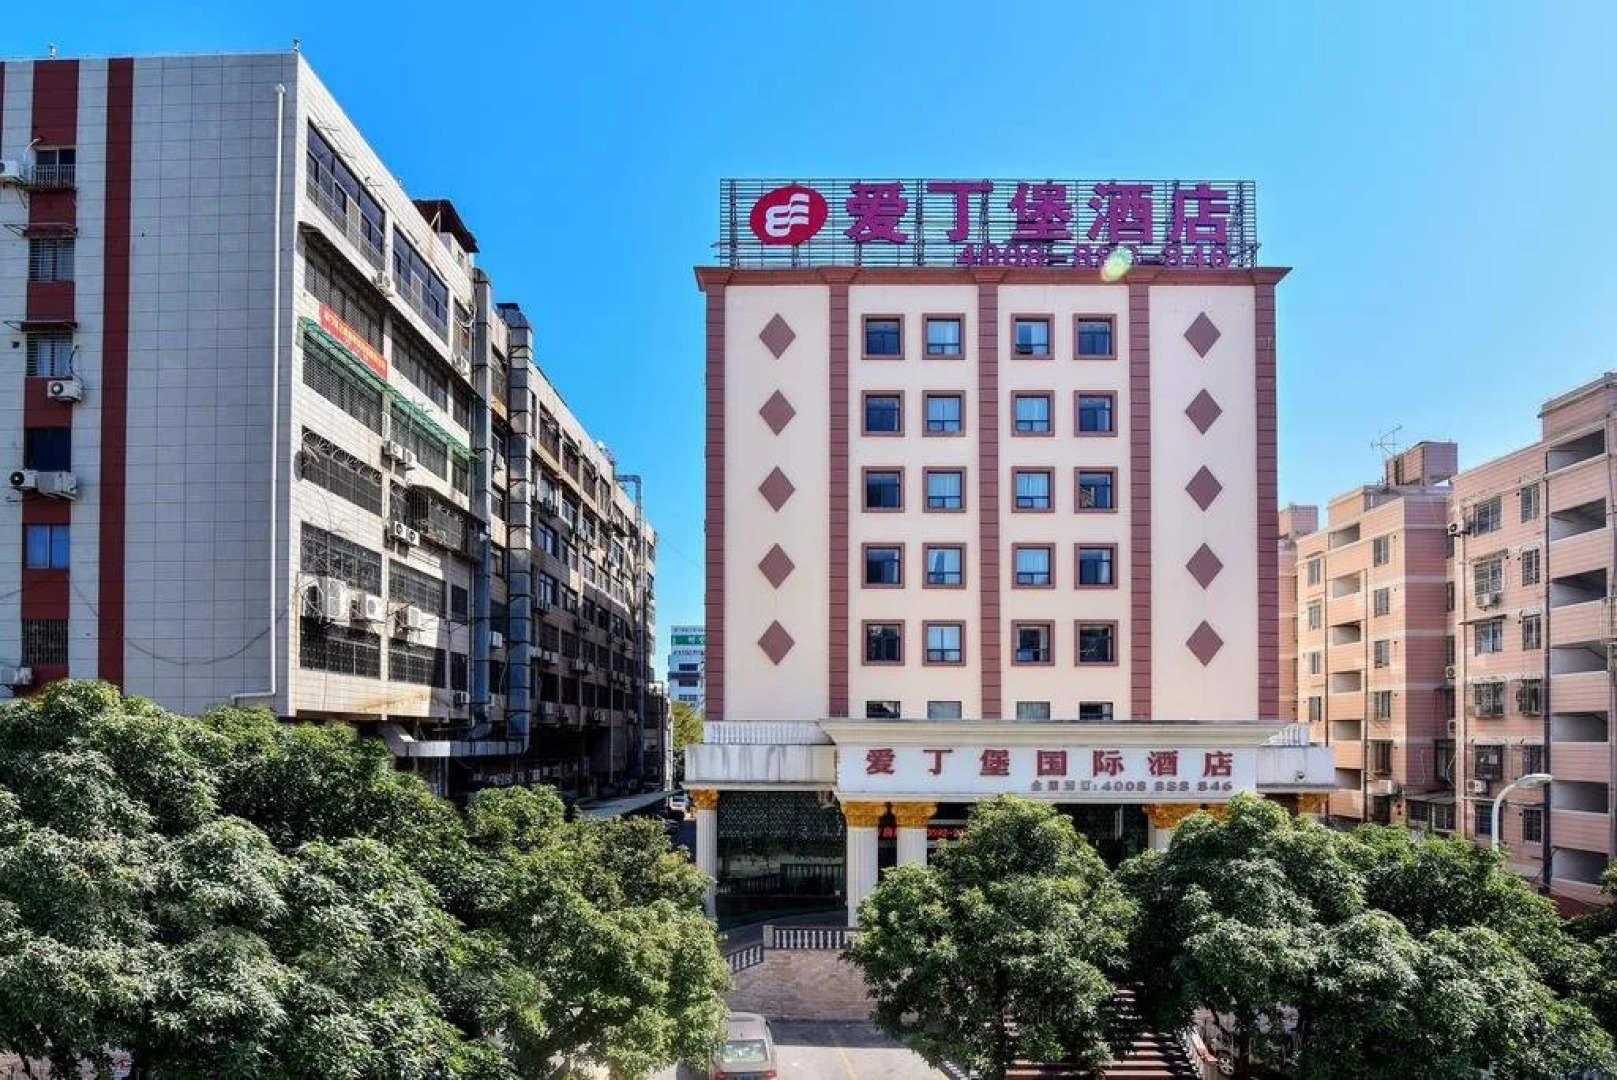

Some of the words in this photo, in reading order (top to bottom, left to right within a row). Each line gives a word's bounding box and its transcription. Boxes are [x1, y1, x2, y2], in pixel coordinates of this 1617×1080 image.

[844, 180, 1231, 244] 爱丁堡酒店
[866, 748, 1233, 777] 爱丁堡国际酒店
[1197, 780, 1233, 792] 846
